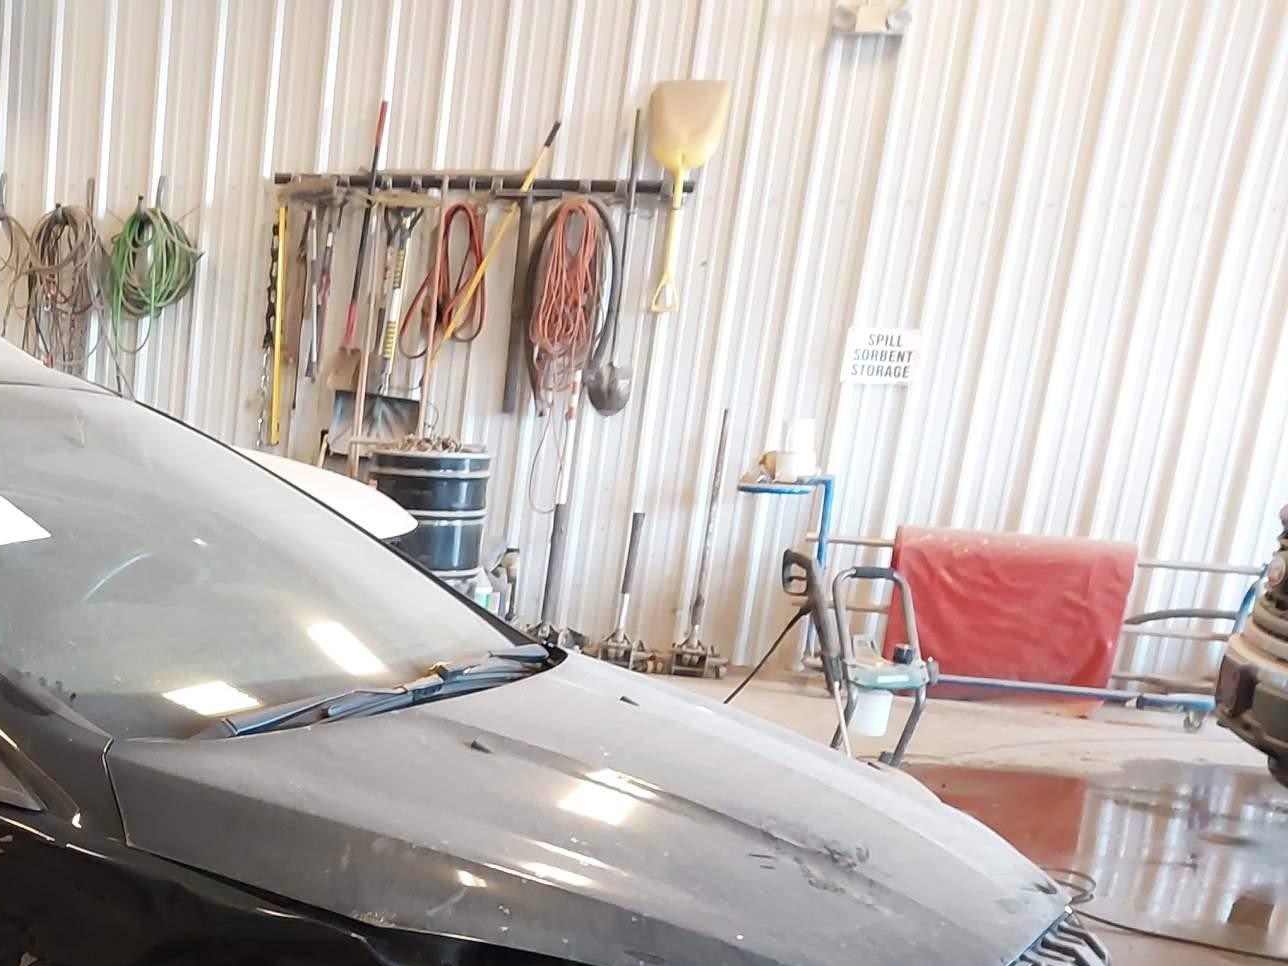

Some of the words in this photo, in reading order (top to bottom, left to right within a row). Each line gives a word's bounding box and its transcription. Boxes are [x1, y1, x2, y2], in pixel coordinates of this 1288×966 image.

[868, 333, 903, 347] SPILL
[853, 348, 914, 363] SORBENT
[851, 363, 910, 378] STORAGE
